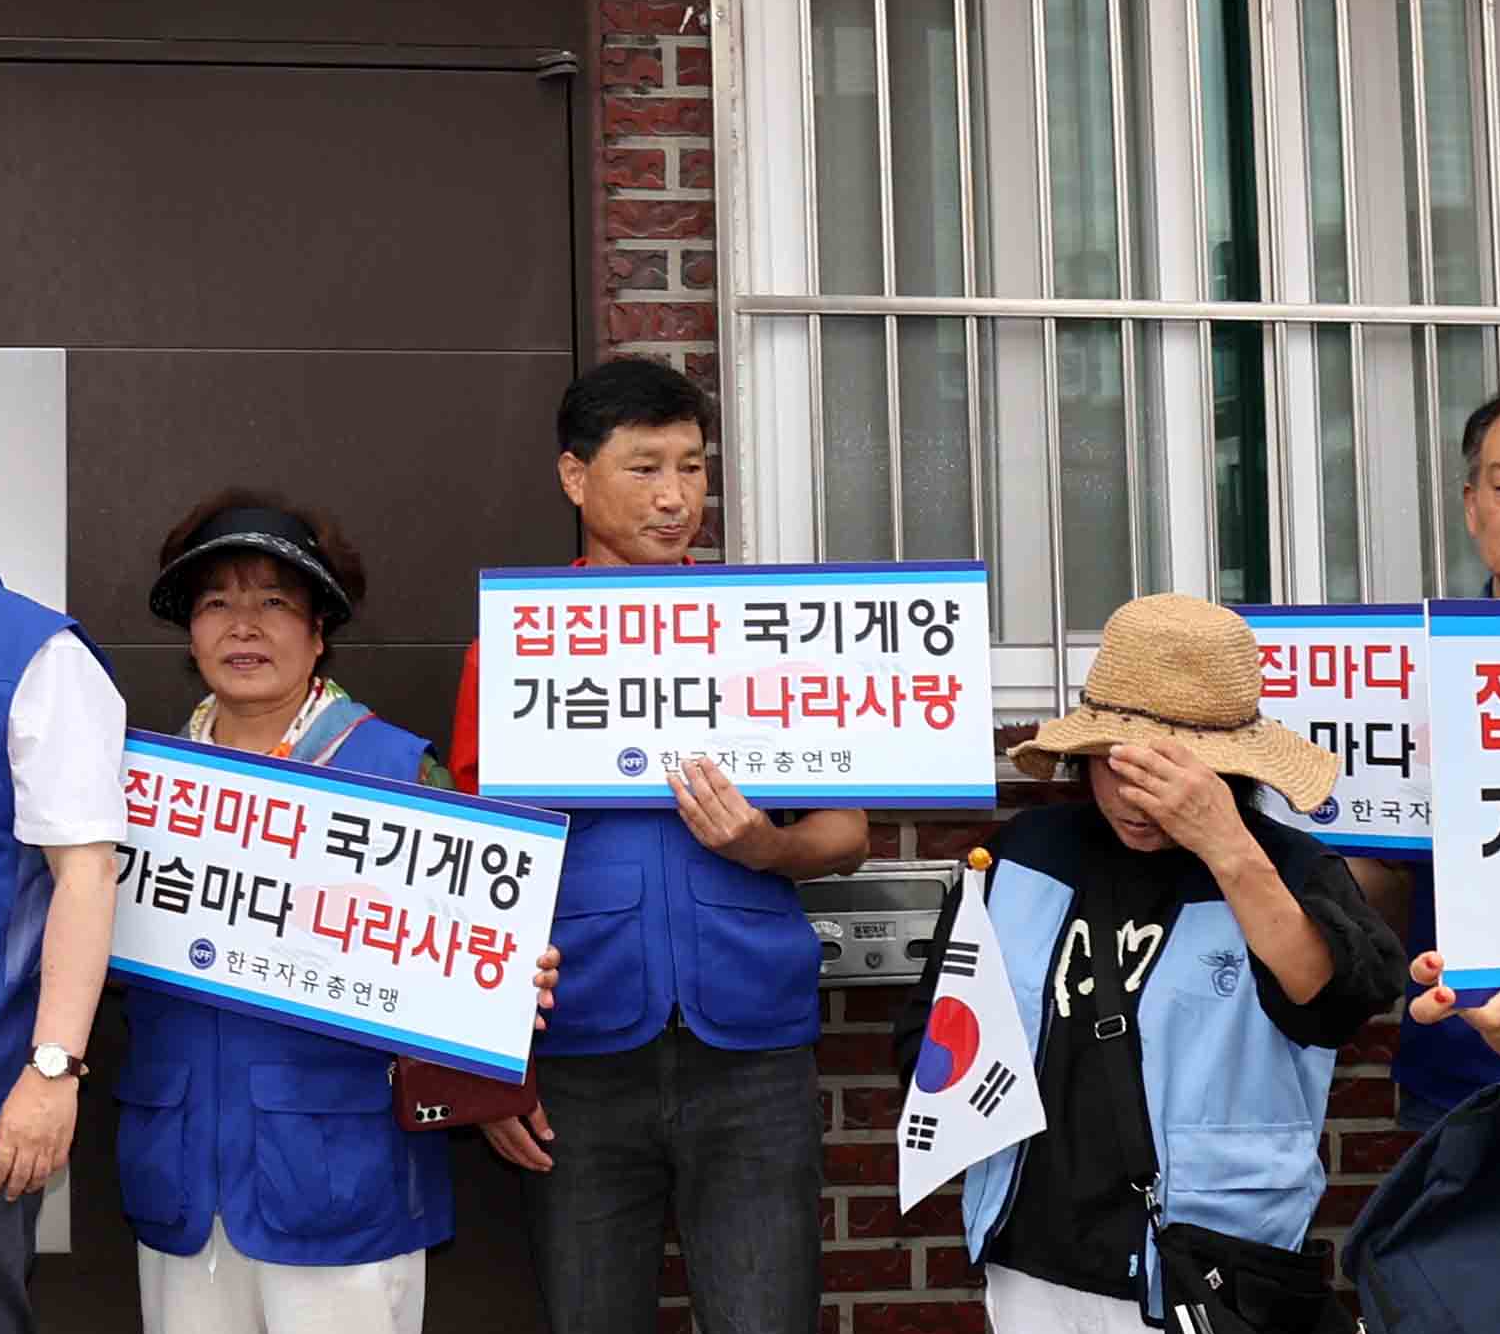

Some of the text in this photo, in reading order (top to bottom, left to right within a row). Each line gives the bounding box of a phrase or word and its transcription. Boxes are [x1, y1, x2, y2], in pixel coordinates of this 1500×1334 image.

[513, 599, 960, 656] 집집마다 국기게양
[1258, 645, 1416, 699] 집마다
[513, 674, 962, 730] 가슴마다 나라사랑
[1309, 721, 1417, 778] 마다
[124, 769, 532, 910] 집집마다 국기게양
[1351, 799, 1432, 825] 한국자
[115, 844, 518, 990] 가슴마다 나라사랑
[226, 948, 399, 1014] 한국자유총연맹
